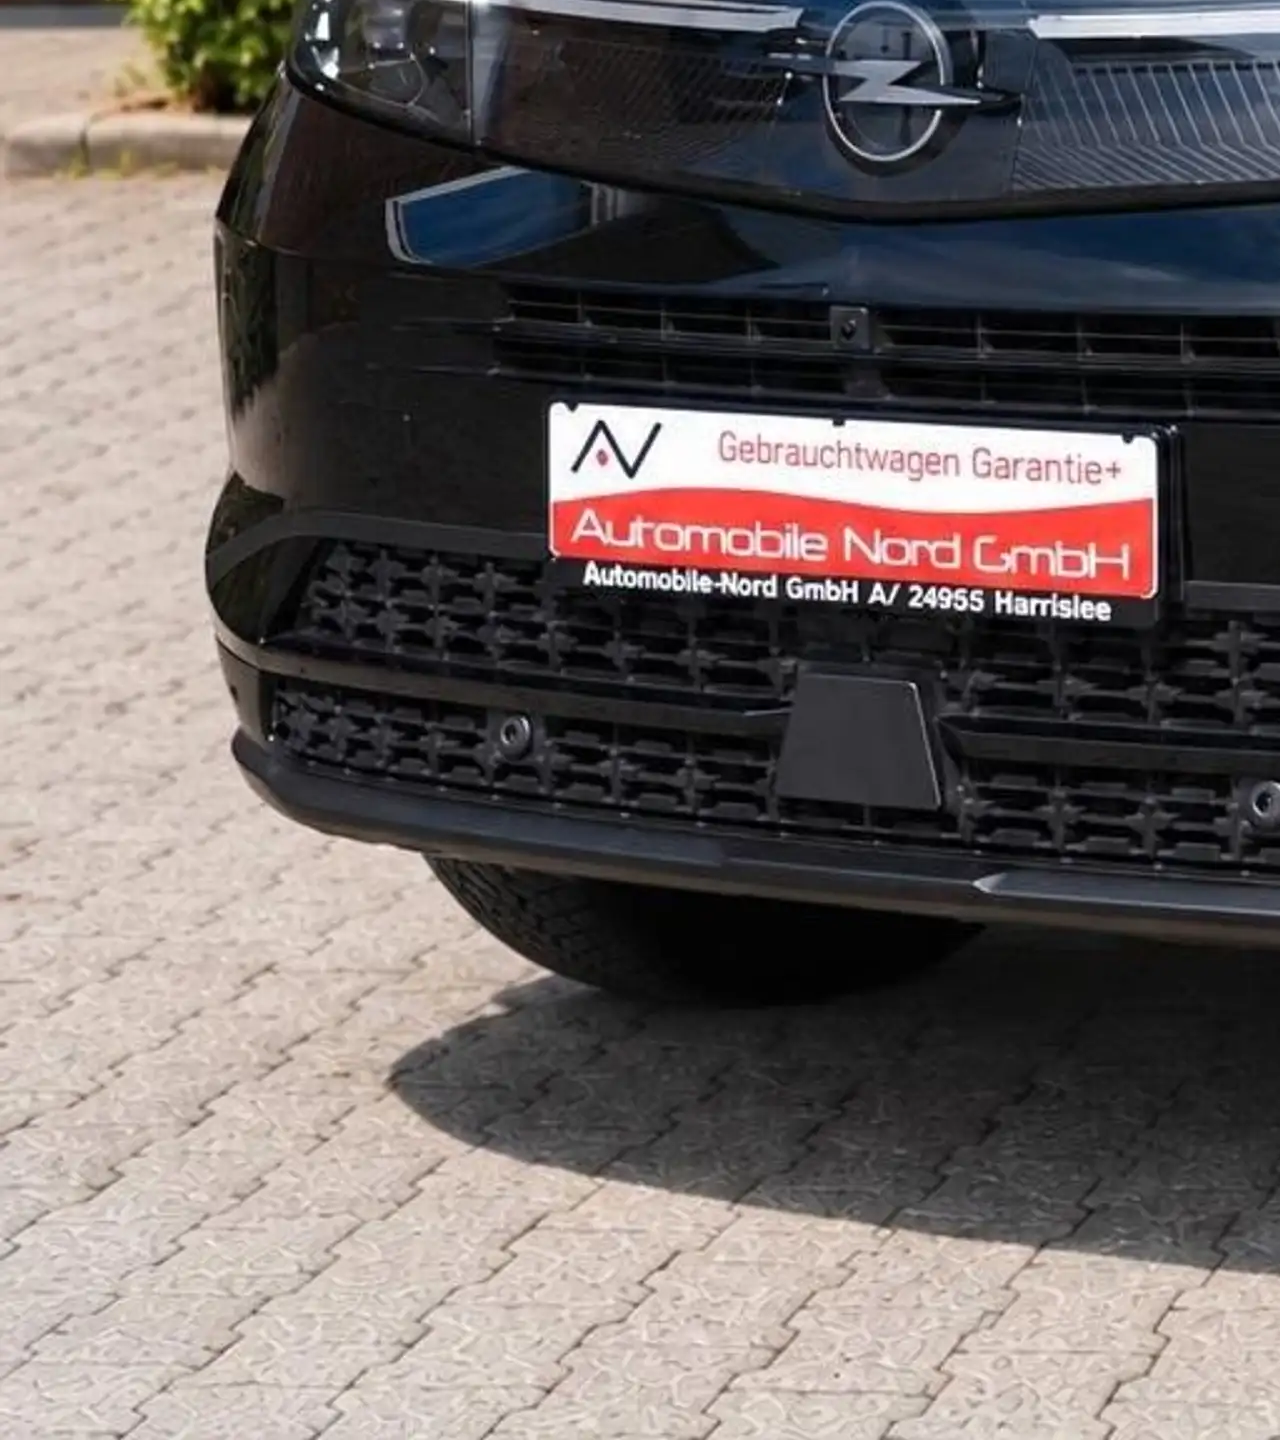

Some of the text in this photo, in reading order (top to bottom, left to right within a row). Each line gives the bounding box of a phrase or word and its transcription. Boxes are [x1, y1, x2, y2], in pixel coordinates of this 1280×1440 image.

[717, 429, 1122, 485] Gebrauchtwagen Garantie+
[571, 507, 1130, 580] Automobile Nord GmbH
[582, 560, 777, 598] Automobile-Nord
[786, 576, 859, 603] GmbH
[908, 584, 985, 612] 24955
[994, 590, 1112, 621] Harrislee
